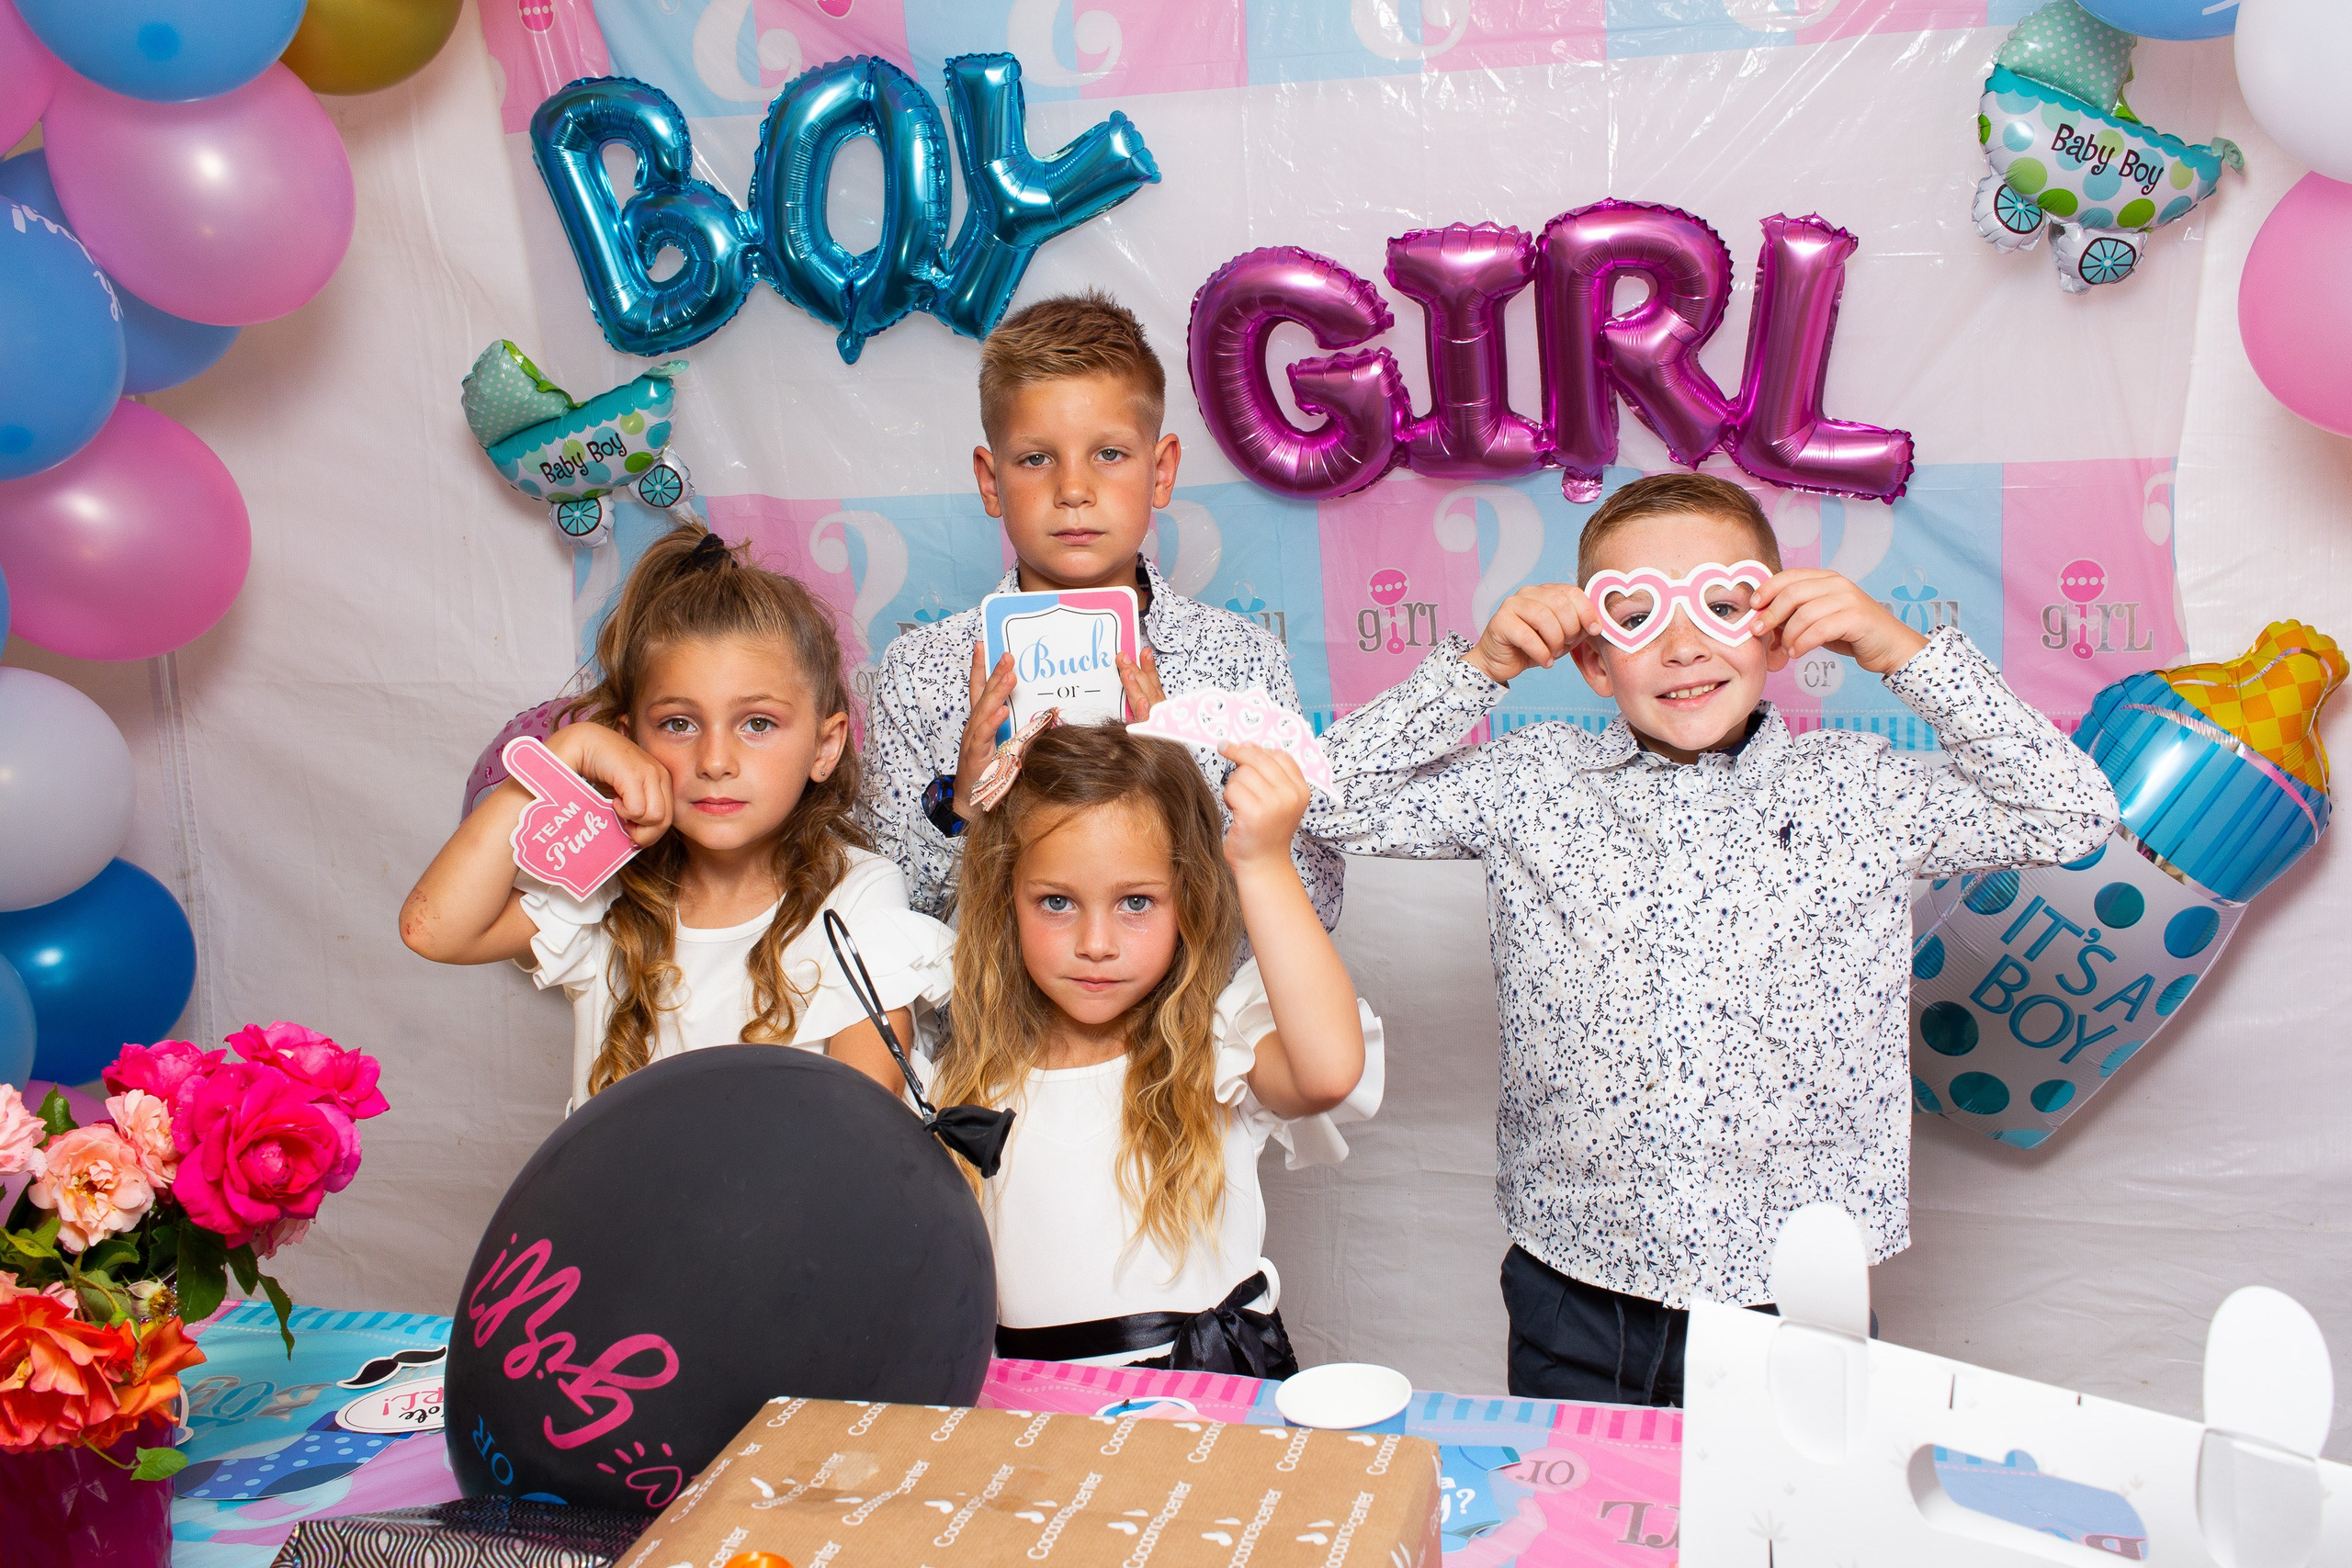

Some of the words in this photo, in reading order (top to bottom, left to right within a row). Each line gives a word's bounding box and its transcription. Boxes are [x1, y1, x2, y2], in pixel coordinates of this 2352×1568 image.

[2051, 123, 2116, 175] Baby
[2119, 149, 2165, 196] Boy
[530, 51, 1161, 364] BOY
[1187, 197, 1915, 504] GIRL
[539, 452, 589, 484] Baby
[586, 432, 628, 463] Boy
[1019, 617, 1114, 682] Buck
[1804, 660, 1836, 688] or
[1057, 685, 1080, 699] or
[532, 801, 582, 844] TEAM
[546, 810, 608, 872] Pink
[2000, 895, 2117, 997] IT'S
[2092, 973, 2156, 1022] A
[1969, 953, 2118, 1065] BOY
[472, 1415, 513, 1484] OR
